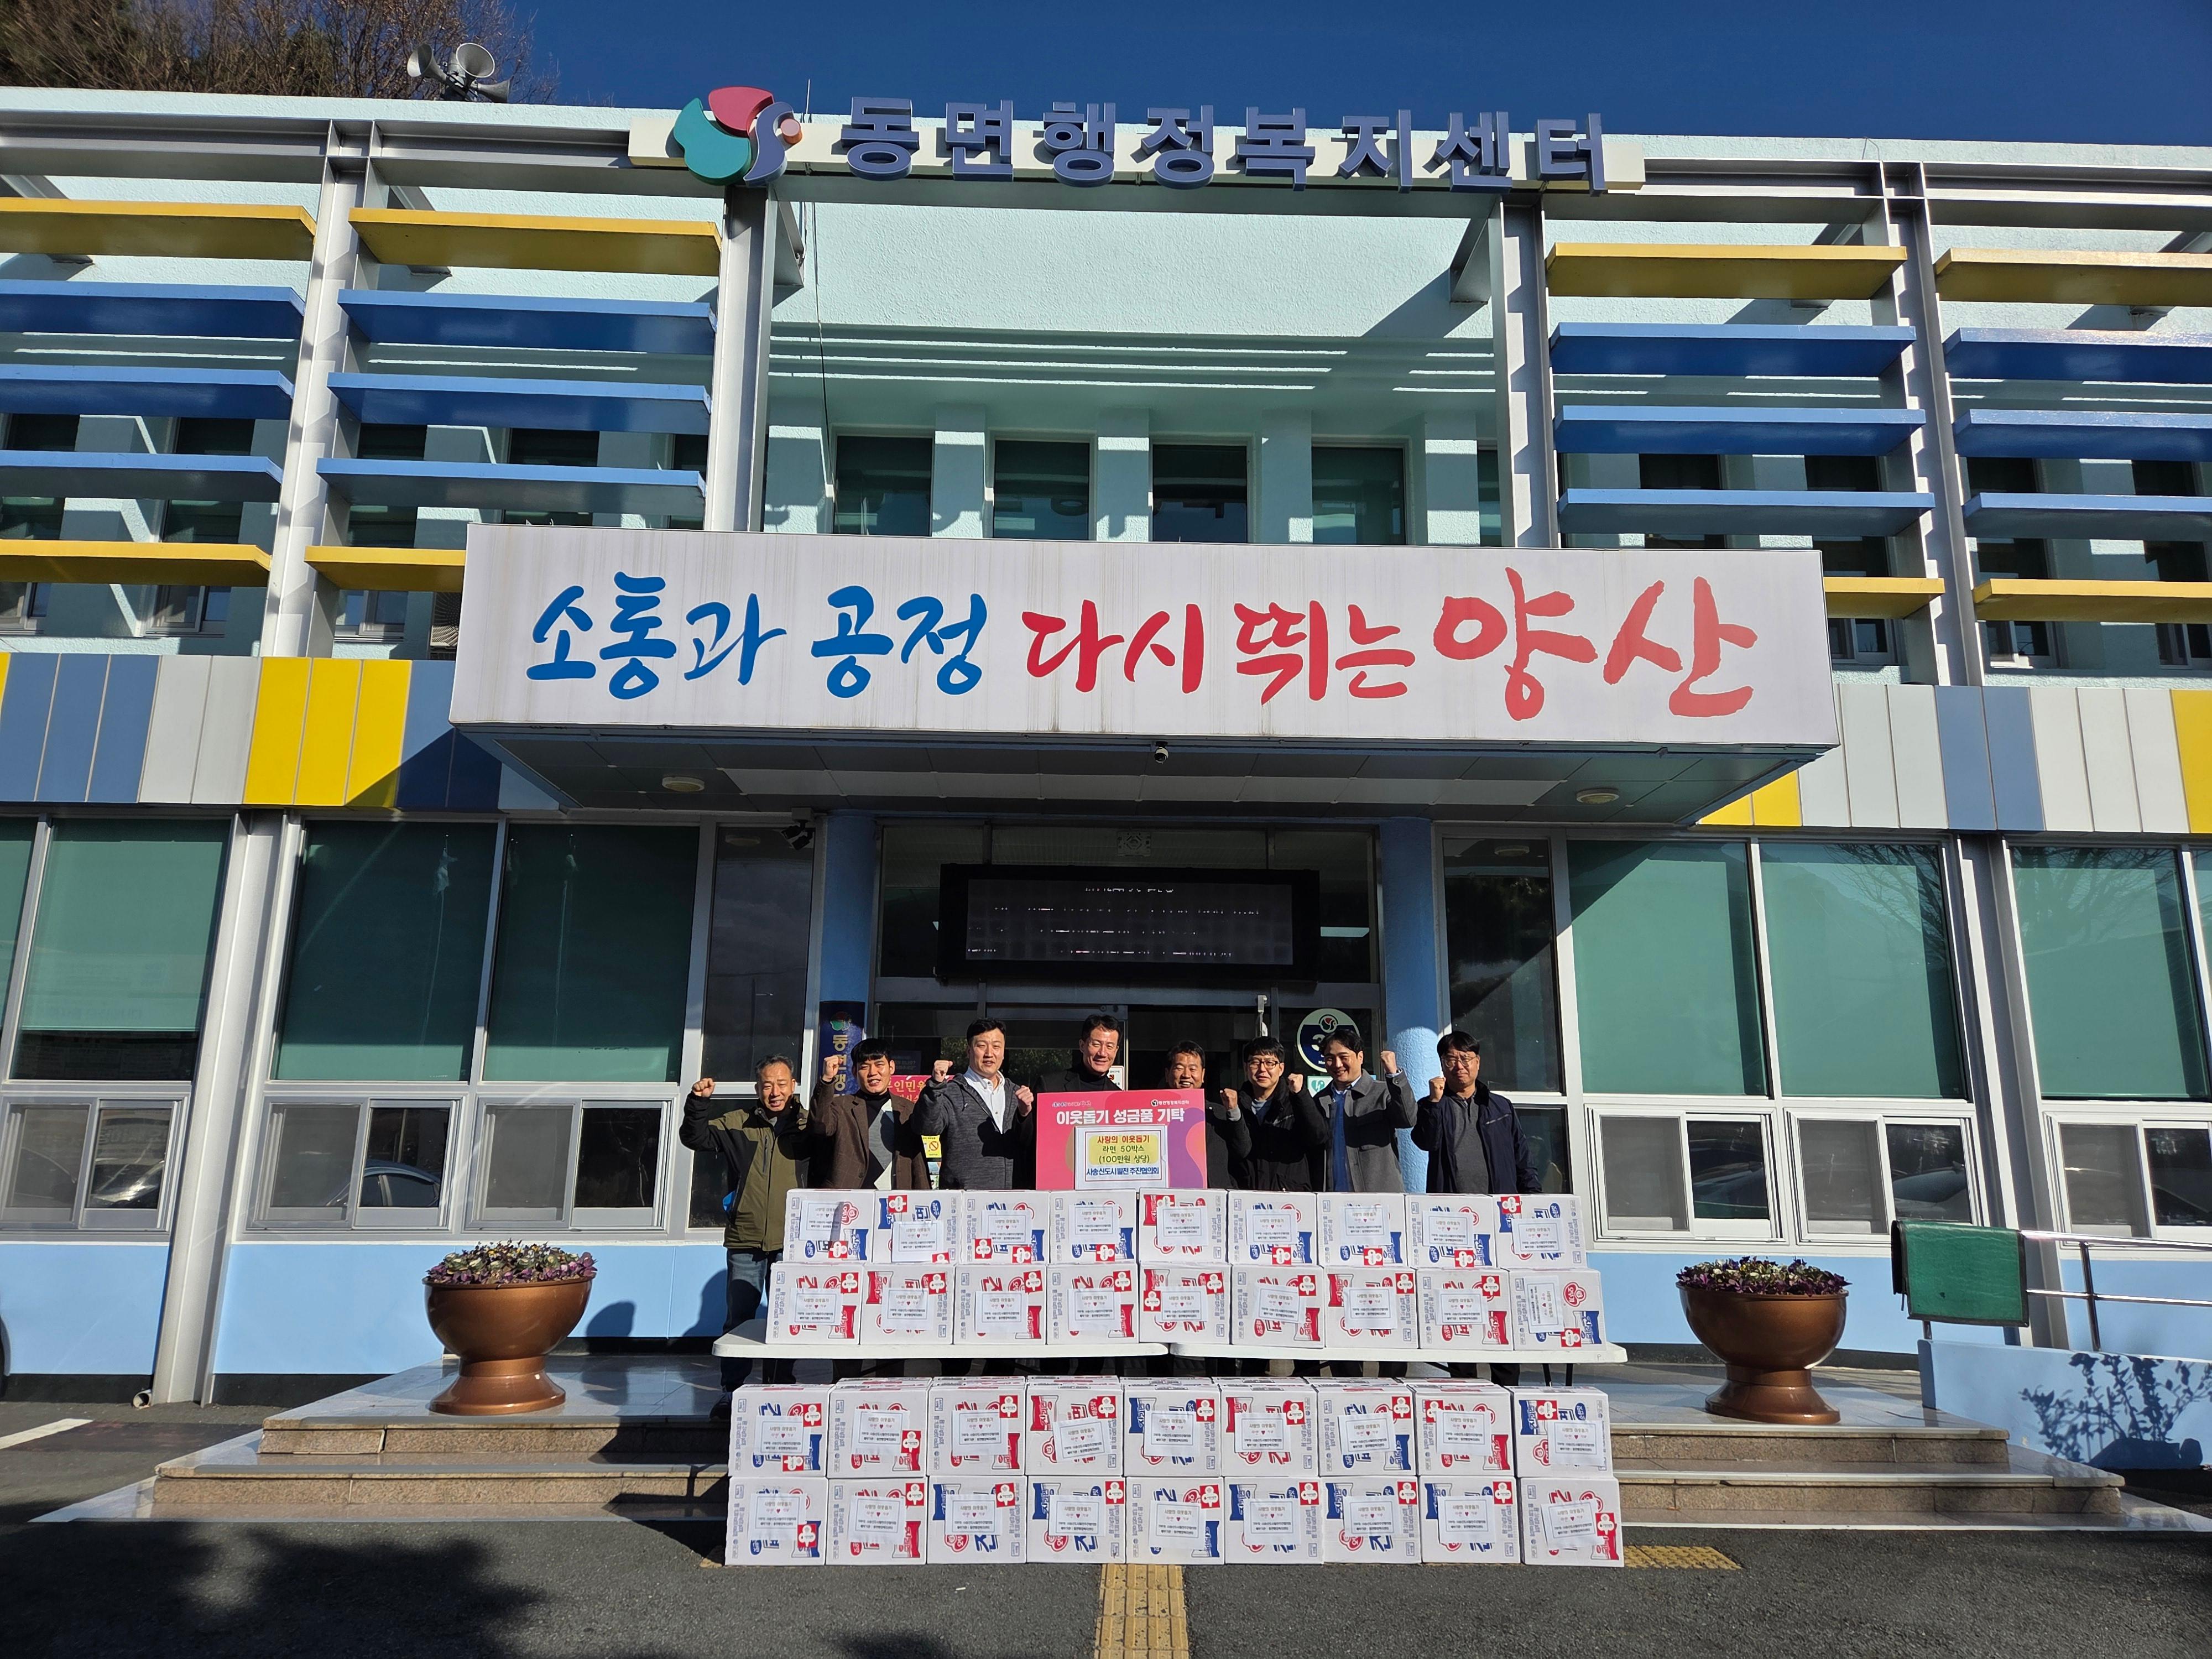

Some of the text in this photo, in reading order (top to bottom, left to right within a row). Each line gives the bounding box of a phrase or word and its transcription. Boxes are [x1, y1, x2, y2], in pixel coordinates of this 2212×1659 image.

[839, 96, 1604, 196] 동면행정복지센터
[526, 567, 1756, 721] 소통과 공정 다시 뛰는 양산
[1056, 1108, 1185, 1124] 이웃돕기 성금품 기탁
[1097, 1135, 1150, 1144] 사랑의 이웃돕기
[1103, 1145, 1145, 1154] 라면 50박스
[1099, 1155, 1150, 1164] (100만원 상당)
